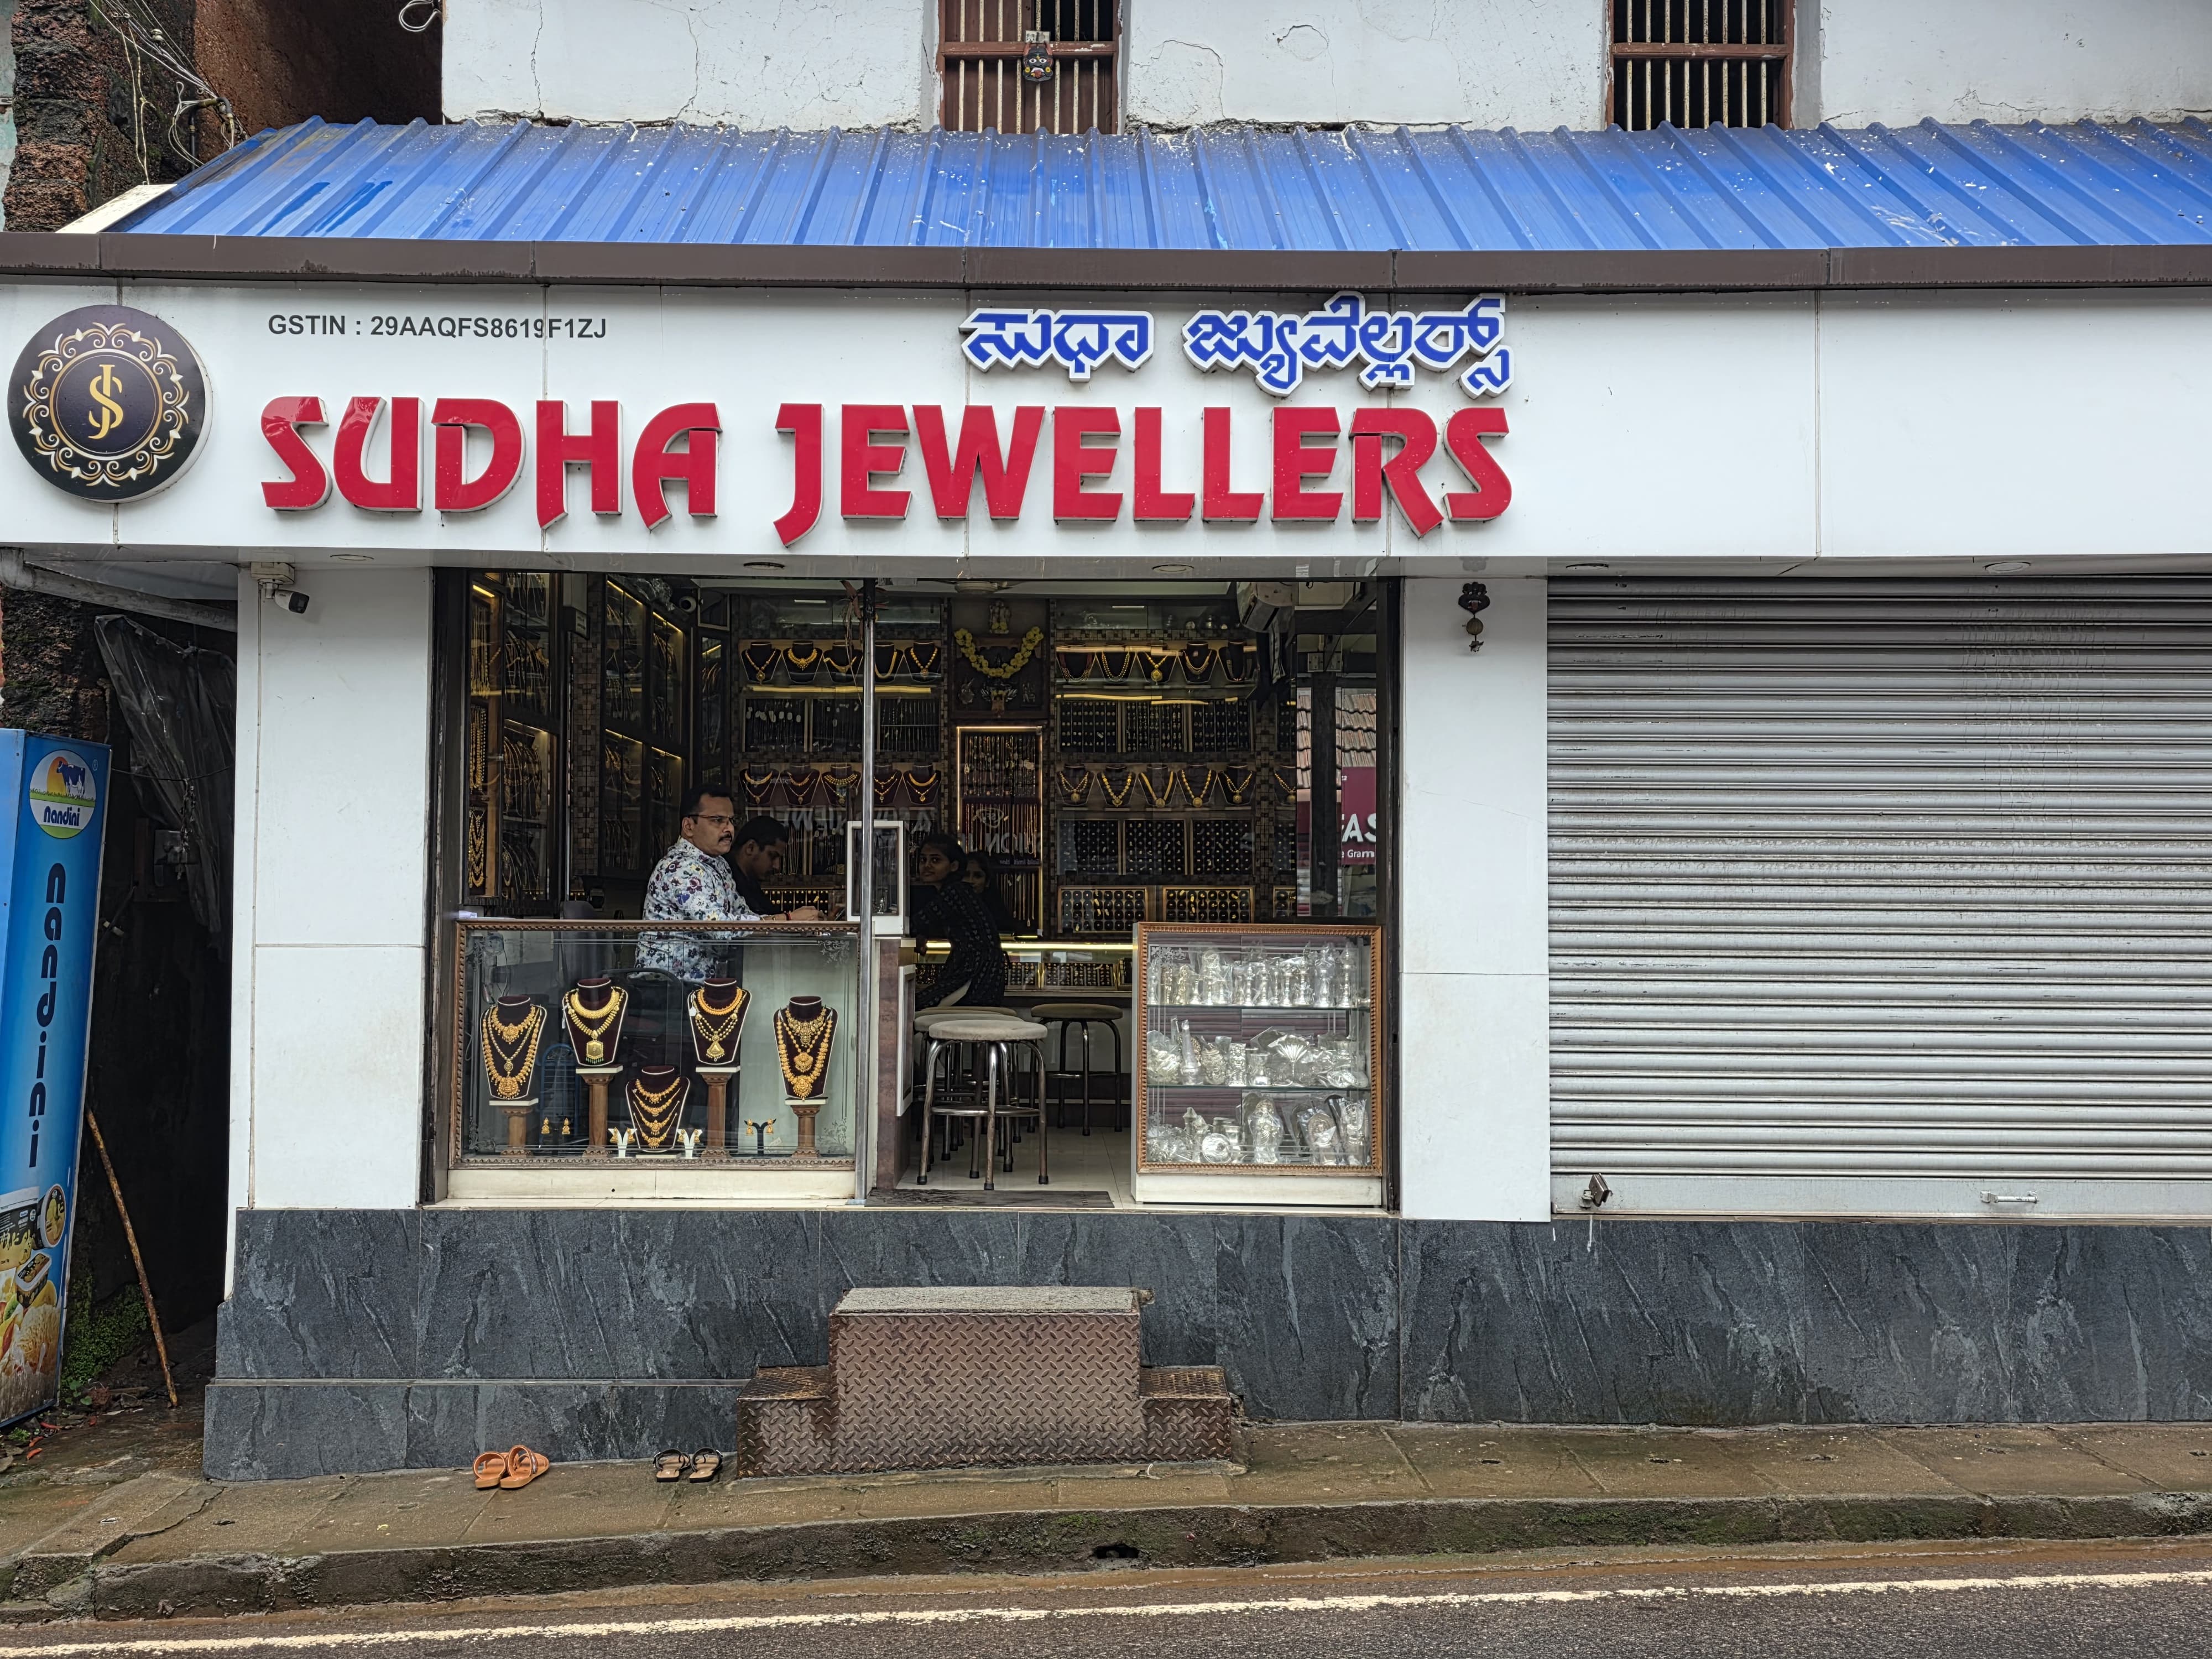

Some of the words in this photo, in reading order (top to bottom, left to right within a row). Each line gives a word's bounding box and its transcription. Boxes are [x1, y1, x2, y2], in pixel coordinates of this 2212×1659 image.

[268, 315, 345, 335] GSTIN
[371, 316, 606, 338] 29AAQFS8619F1ZJ
[967, 312, 1149, 374] ಸುಧಾ
[260, 397, 721, 528] SUDHA
[774, 404, 1512, 545] JEWELLERS
